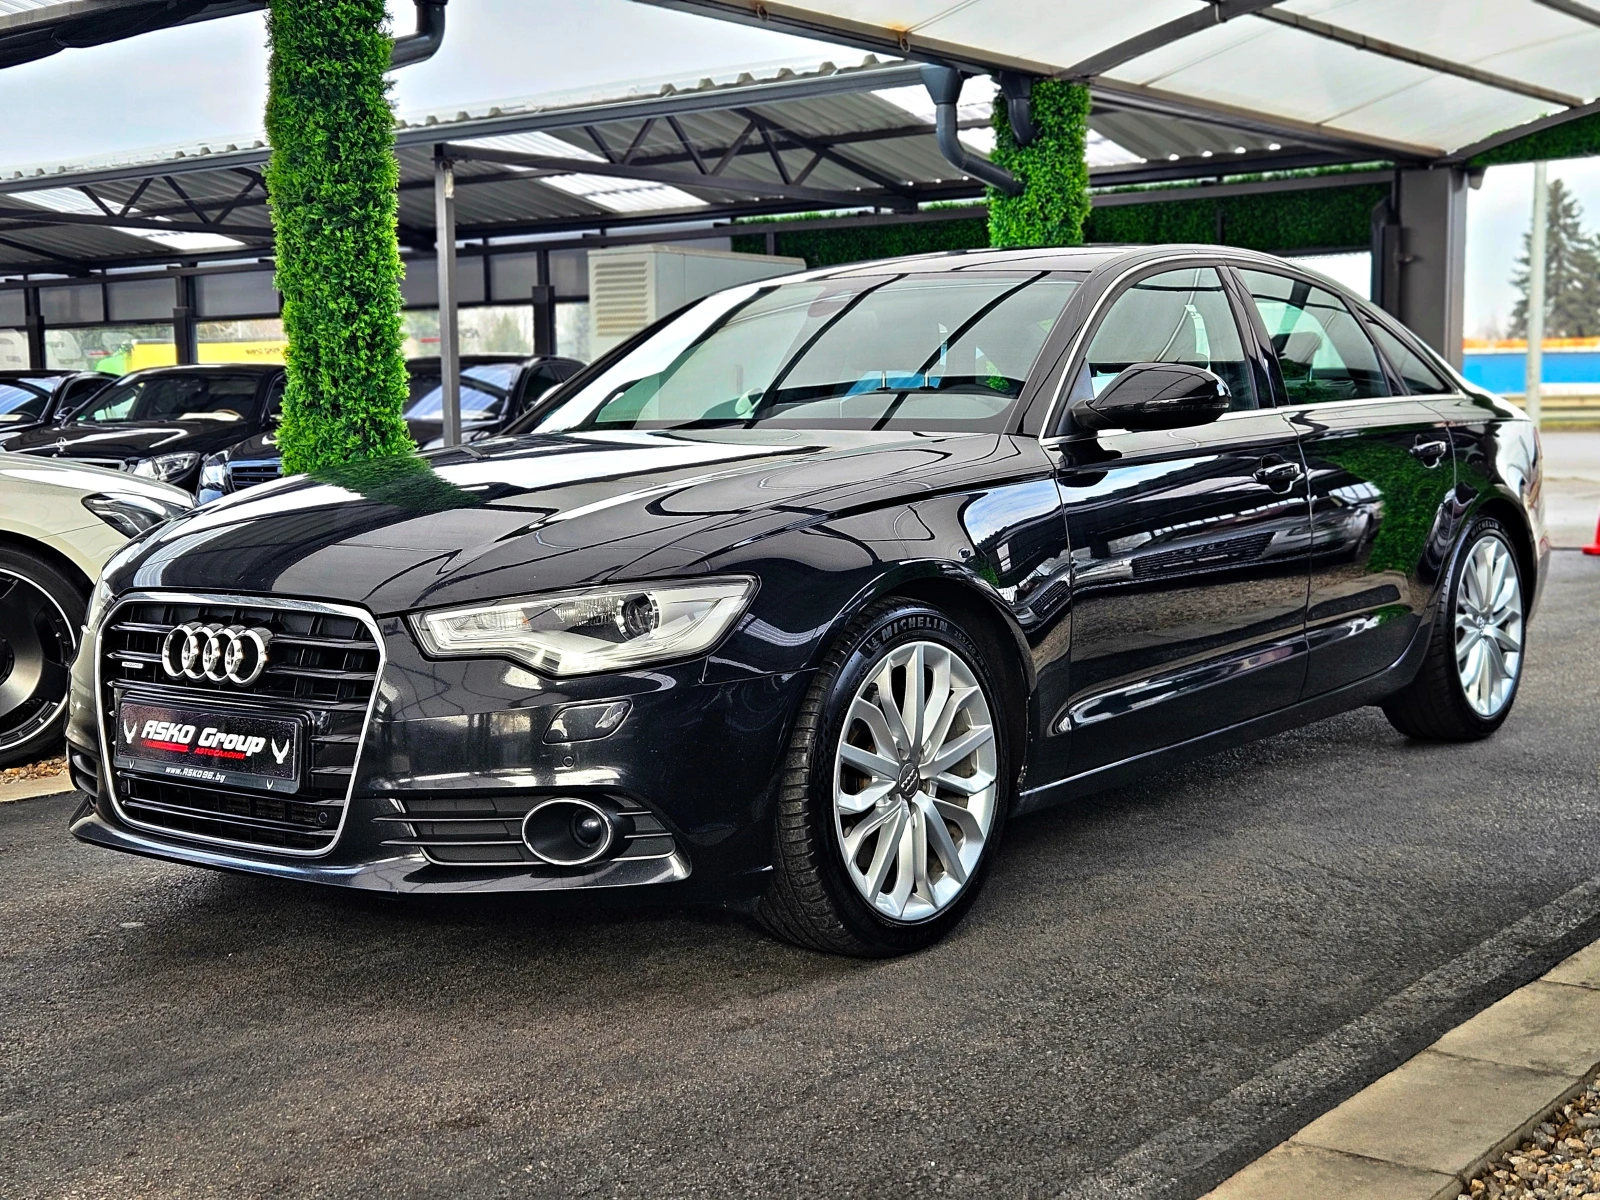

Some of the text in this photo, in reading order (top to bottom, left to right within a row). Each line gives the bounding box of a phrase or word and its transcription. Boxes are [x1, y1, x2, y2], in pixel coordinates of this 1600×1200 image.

[1470, 520, 1499, 537] MICHELIN
[881, 616, 948, 641] MICHELIN
[140, 720, 266, 757] ASKO Group
[194, 747, 246, 759] АВТОСАЛОНИ
